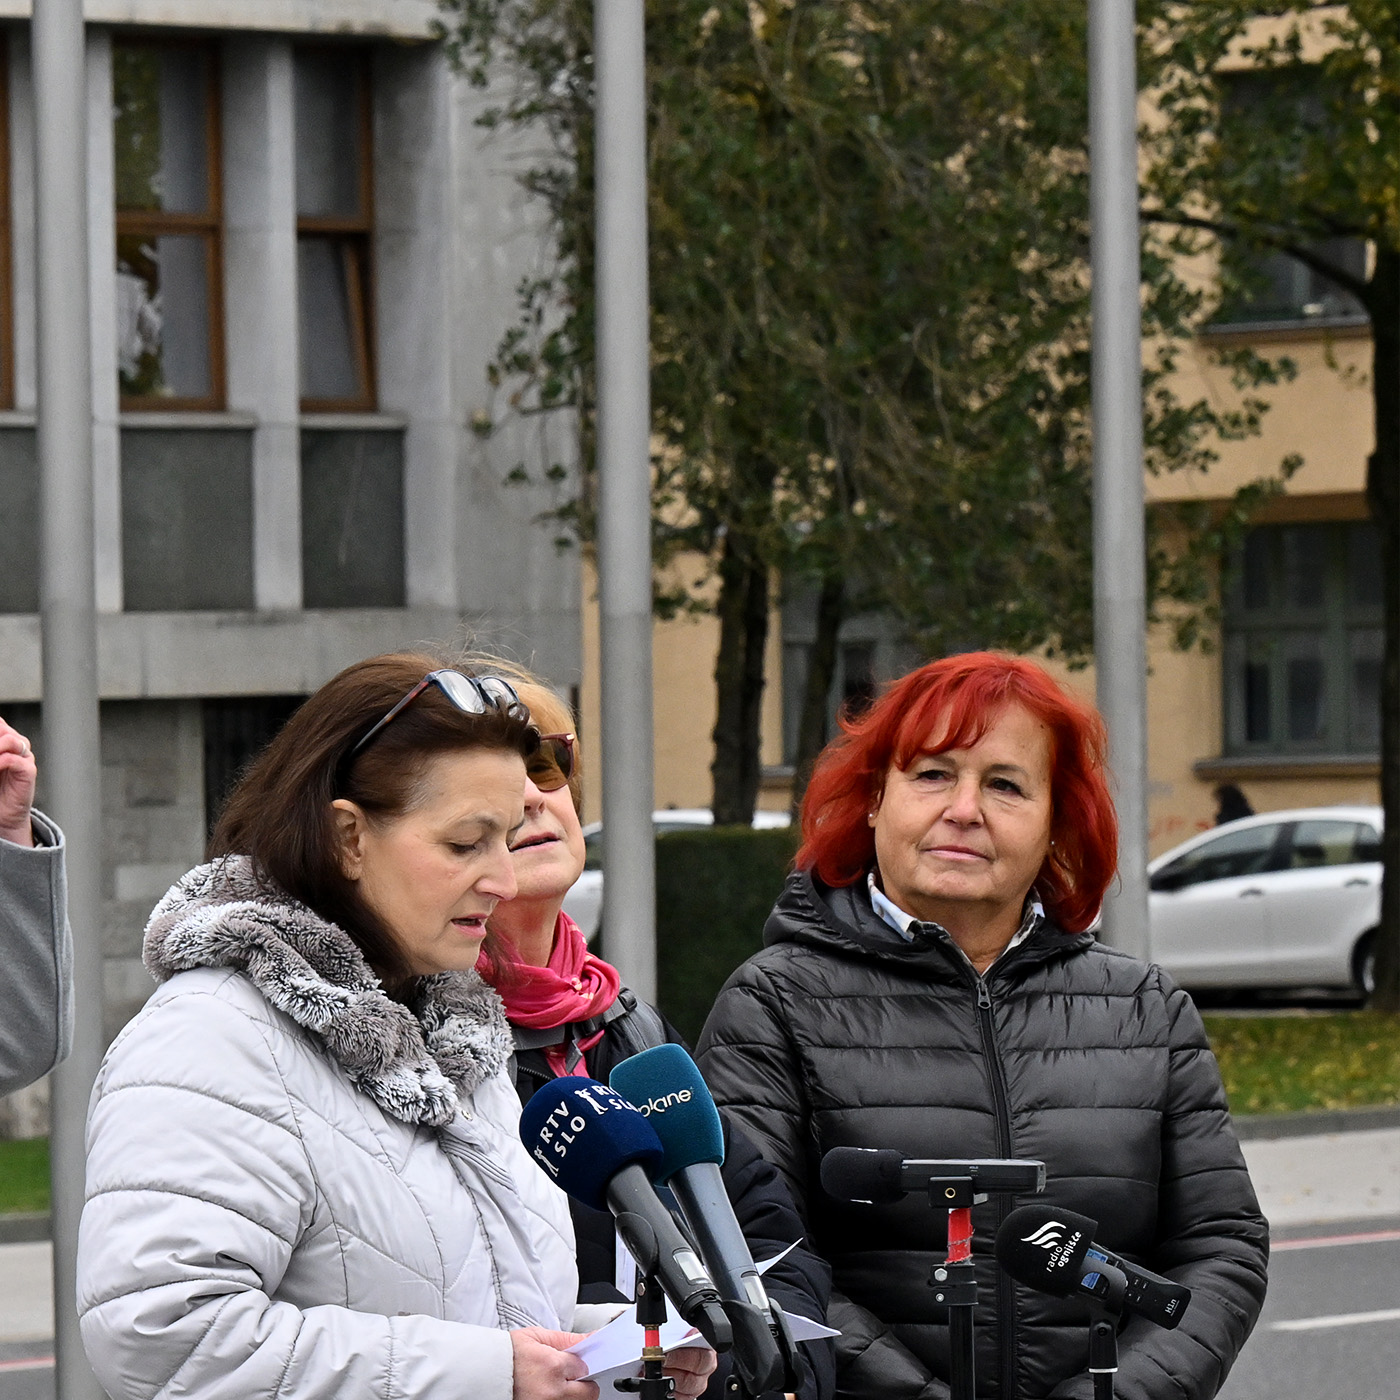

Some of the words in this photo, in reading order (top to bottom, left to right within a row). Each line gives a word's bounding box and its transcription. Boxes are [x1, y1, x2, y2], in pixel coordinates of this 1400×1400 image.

[540, 1101, 569, 1144] RTV
[554, 1116, 585, 1157] SLO
[1046, 1247, 1063, 1272] radio
[1058, 1232, 1082, 1268] ognjišče
